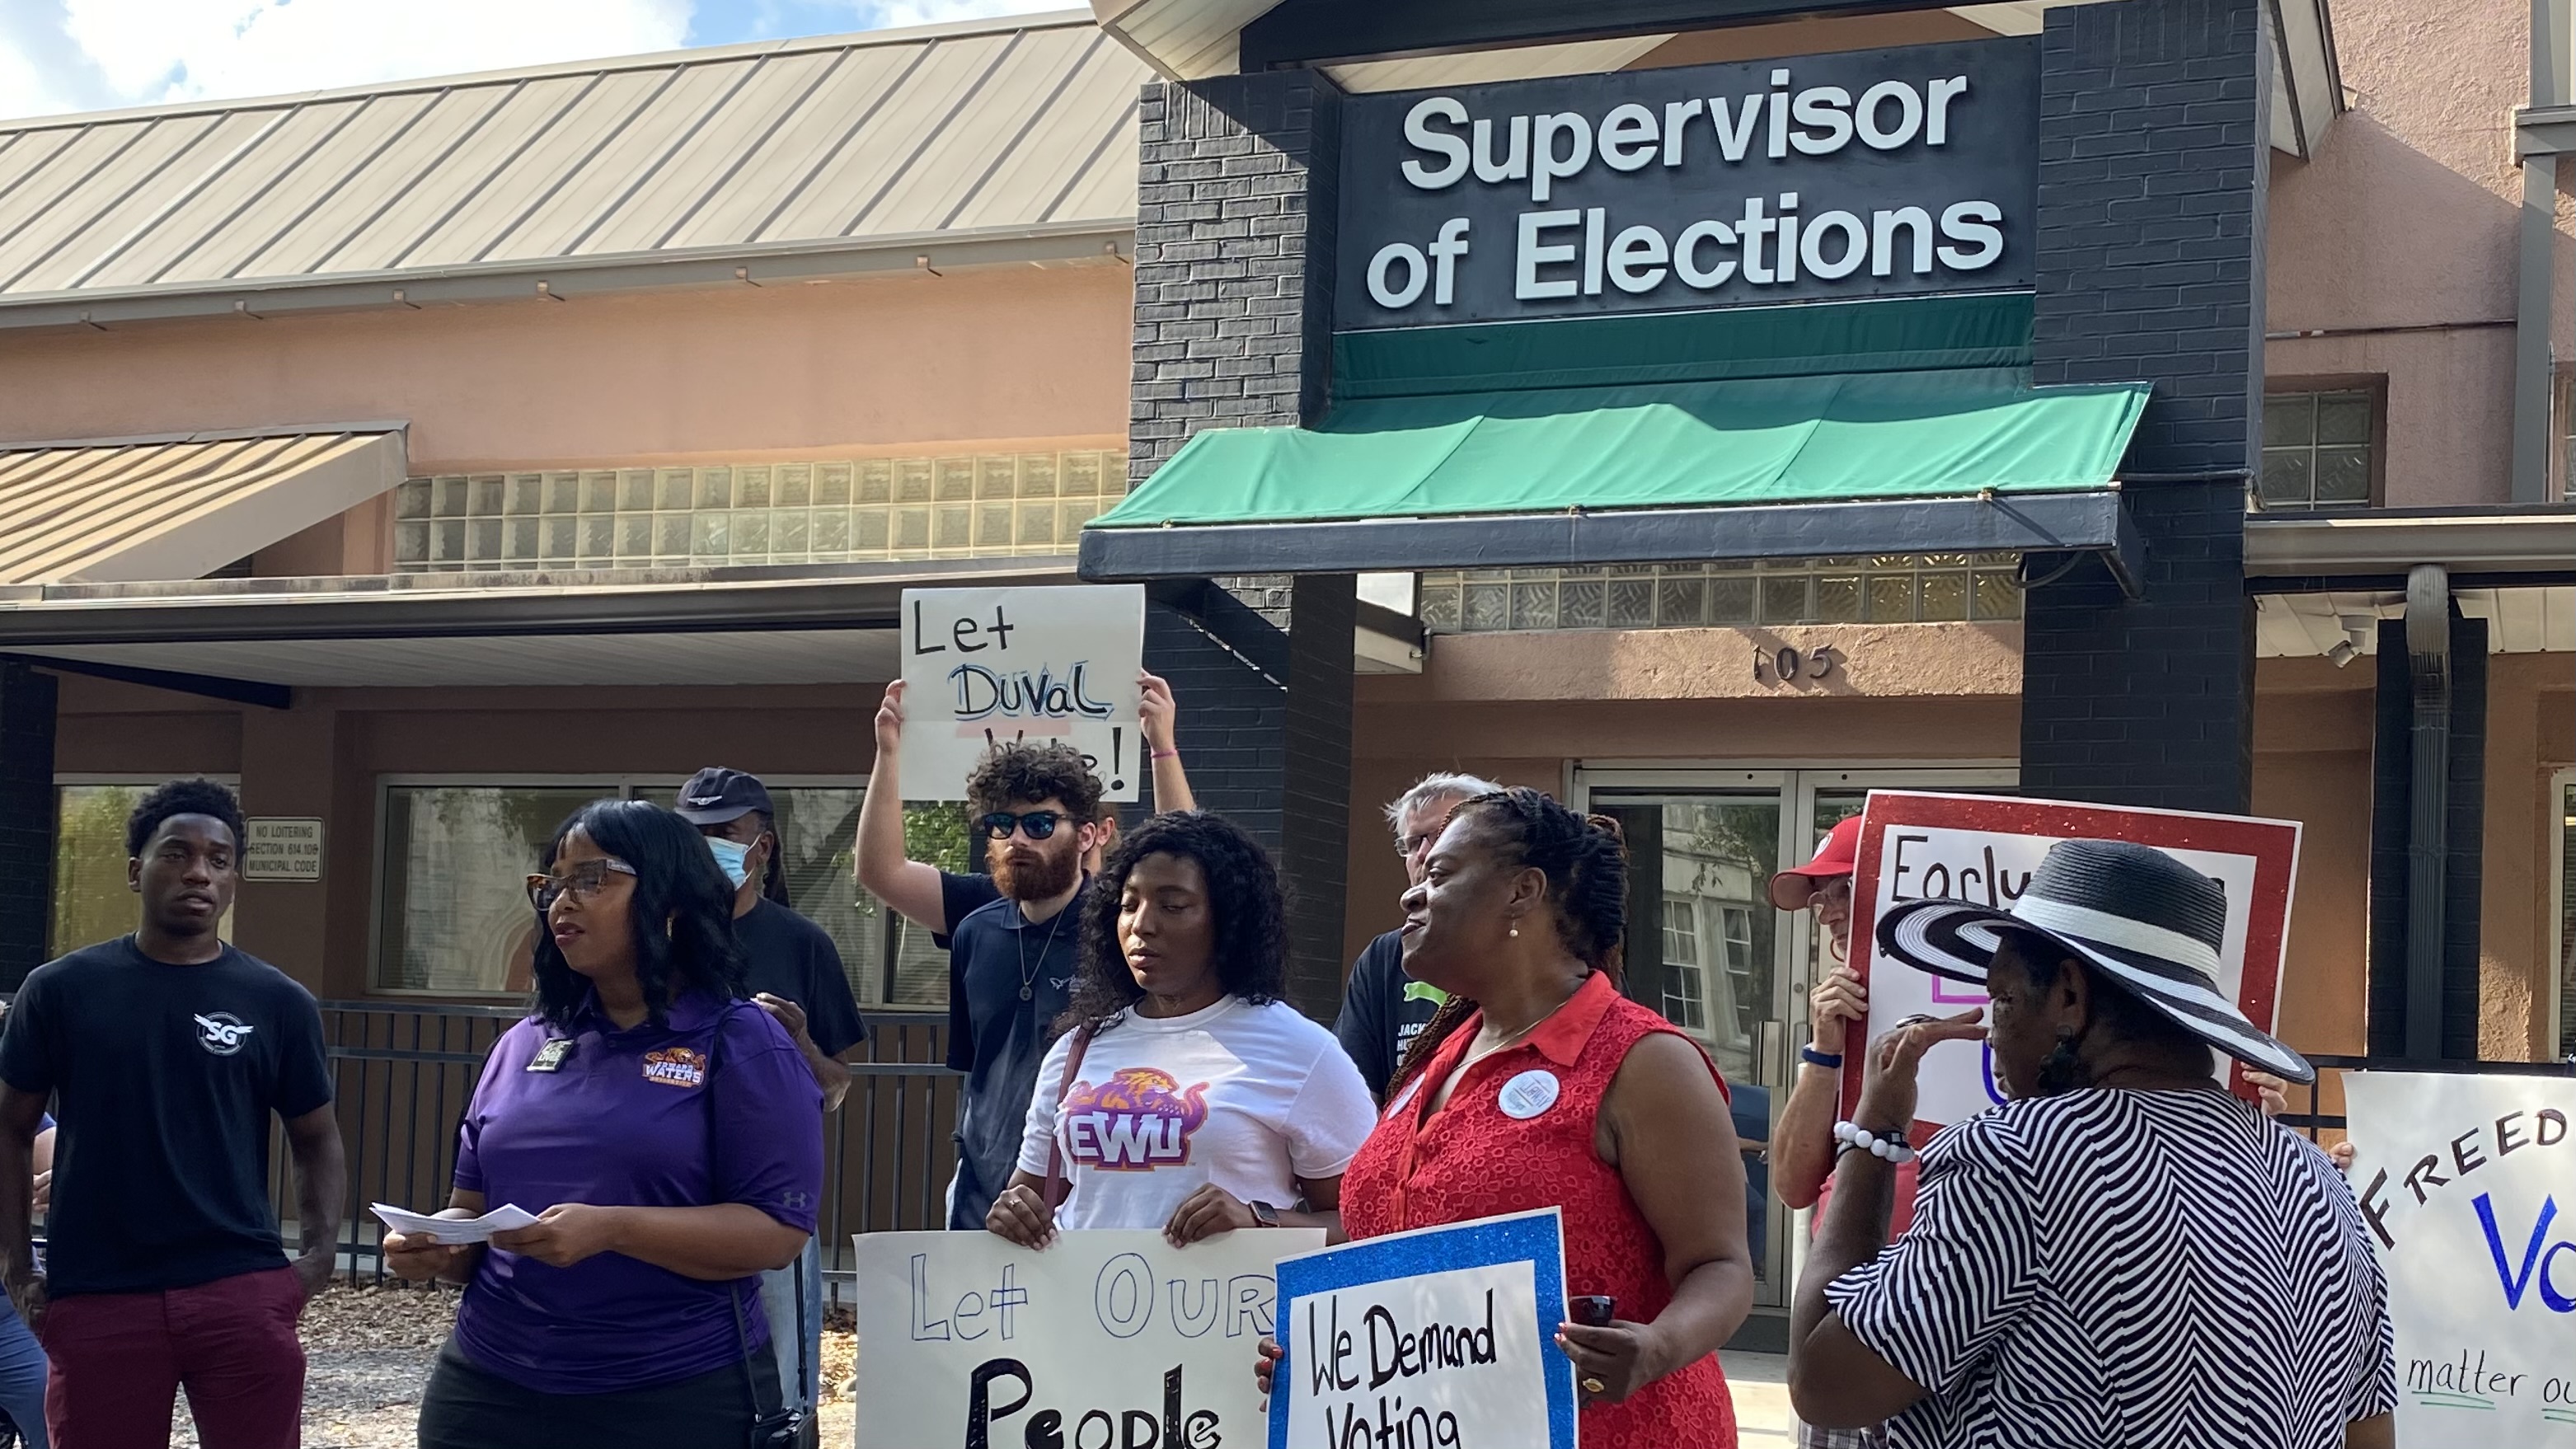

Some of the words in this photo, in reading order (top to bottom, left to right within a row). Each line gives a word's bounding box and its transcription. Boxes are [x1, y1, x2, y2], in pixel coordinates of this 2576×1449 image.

[1401, 68, 1967, 202] Supervisor
[1366, 217, 1471, 308] of
[1514, 191, 2005, 301] Elections
[914, 599, 1014, 655] Let
[1753, 643, 1833, 681] 105
[250, 842, 284, 855] SECTION
[256, 826, 268, 838] NO
[271, 826, 313, 838] LOITERING
[248, 860, 291, 872] MUNICIPAL
[293, 860, 317, 873] CODE
[205, 1021, 238, 1045] SG
[646, 1062, 701, 1084] WATERS
[1068, 1110, 1183, 1163] EWU
[2358, 1108, 2569, 1252] FREED
[911, 1253, 1028, 1341] Let
[1095, 1252, 1276, 1339] OUR
[1309, 1294, 1359, 1397] We
[1363, 1287, 1497, 1392] Demand
[2407, 1348, 2528, 1396] matter
